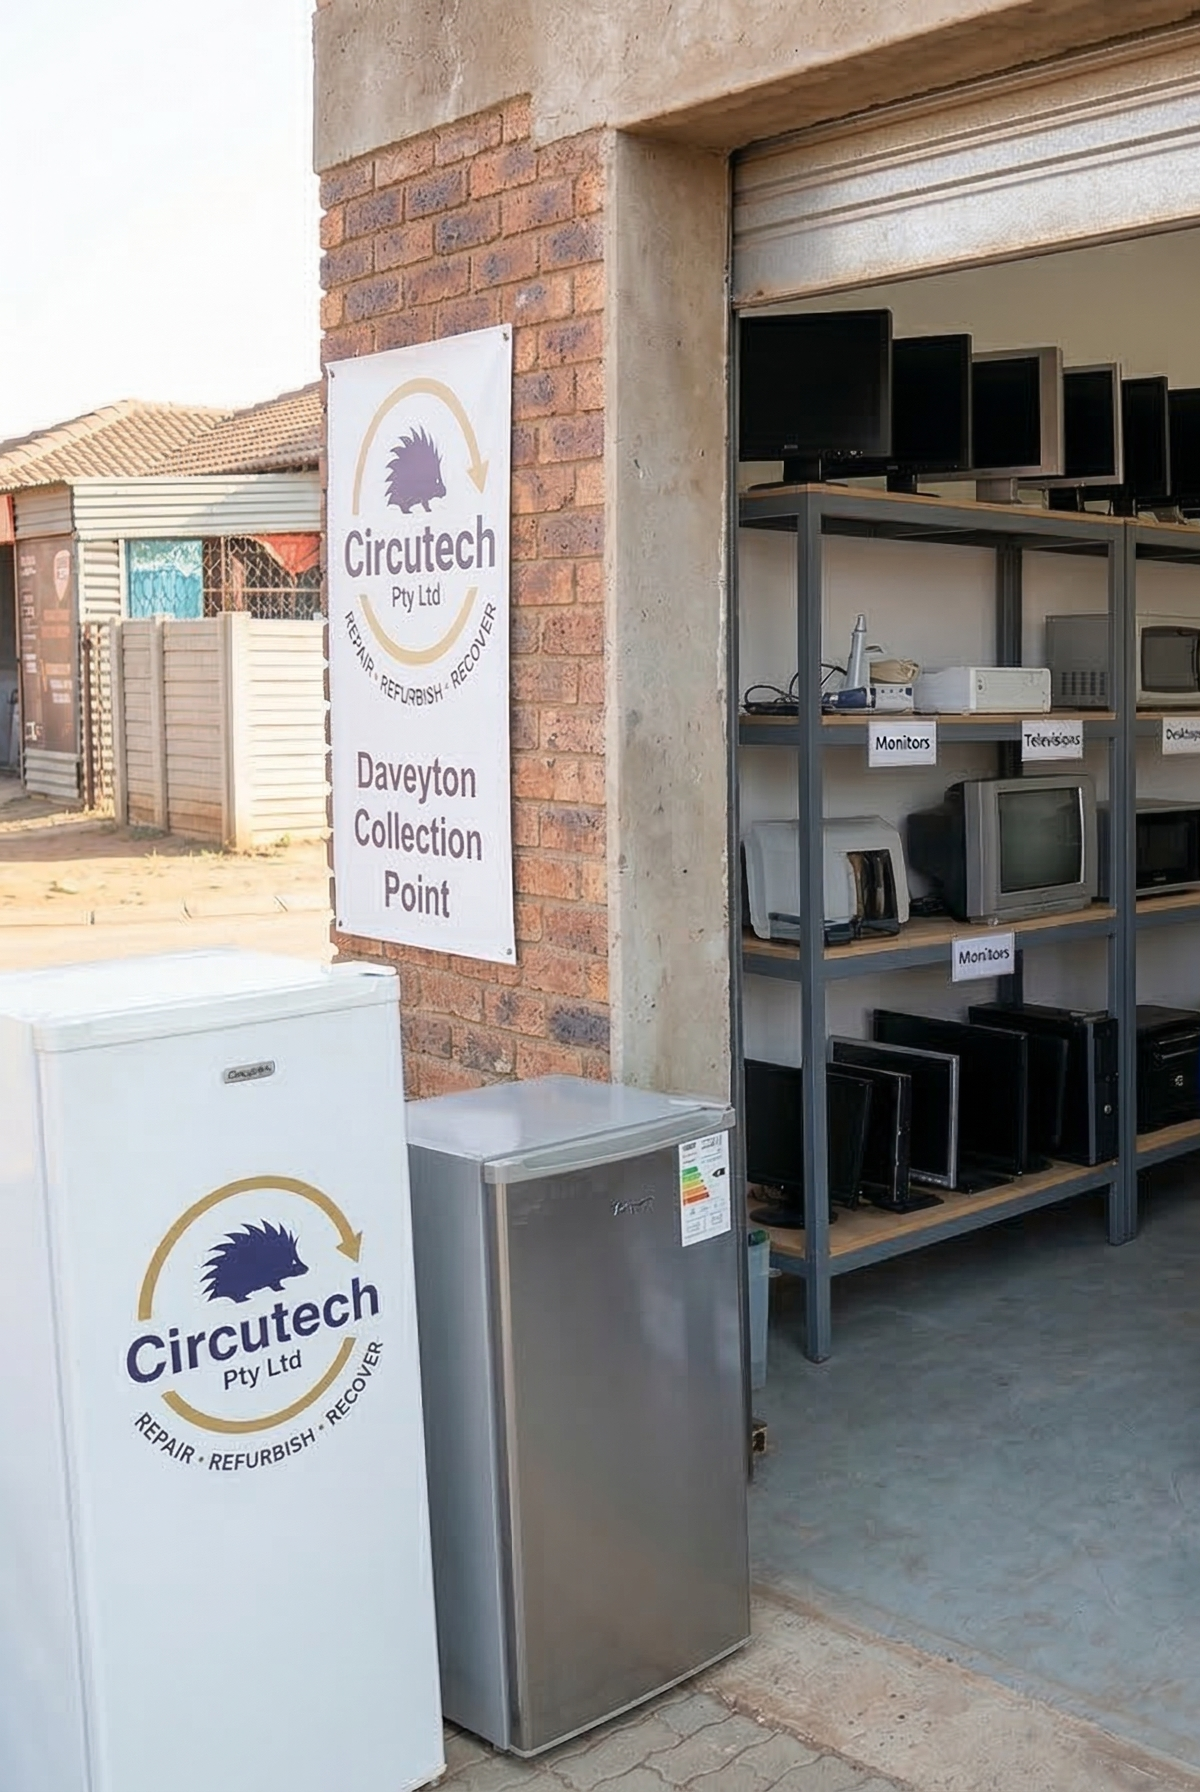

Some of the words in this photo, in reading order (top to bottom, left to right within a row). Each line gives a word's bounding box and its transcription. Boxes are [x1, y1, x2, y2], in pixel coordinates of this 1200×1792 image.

[344, 514, 496, 579] Circutech
[392, 586, 414, 613] Pty
[418, 582, 440, 606] Ltd
[345, 611, 375, 678] REPAIR
[380, 675, 443, 706] REFURBISH
[450, 602, 496, 689] RECOVER
[875, 735, 930, 750] Monitors
[357, 751, 476, 804] Daveyton
[354, 808, 482, 861] Collection
[384, 870, 449, 918] Point
[959, 947, 1010, 964] Monitors
[126, 1277, 379, 1384] Circutech
[223, 1366, 260, 1390] Pty
[267, 1349, 302, 1377] Ltd
[134, 1412, 194, 1464] REPAIR
[208, 1428, 316, 1471] REFURBISH
[325, 1341, 383, 1426] RECOVER
